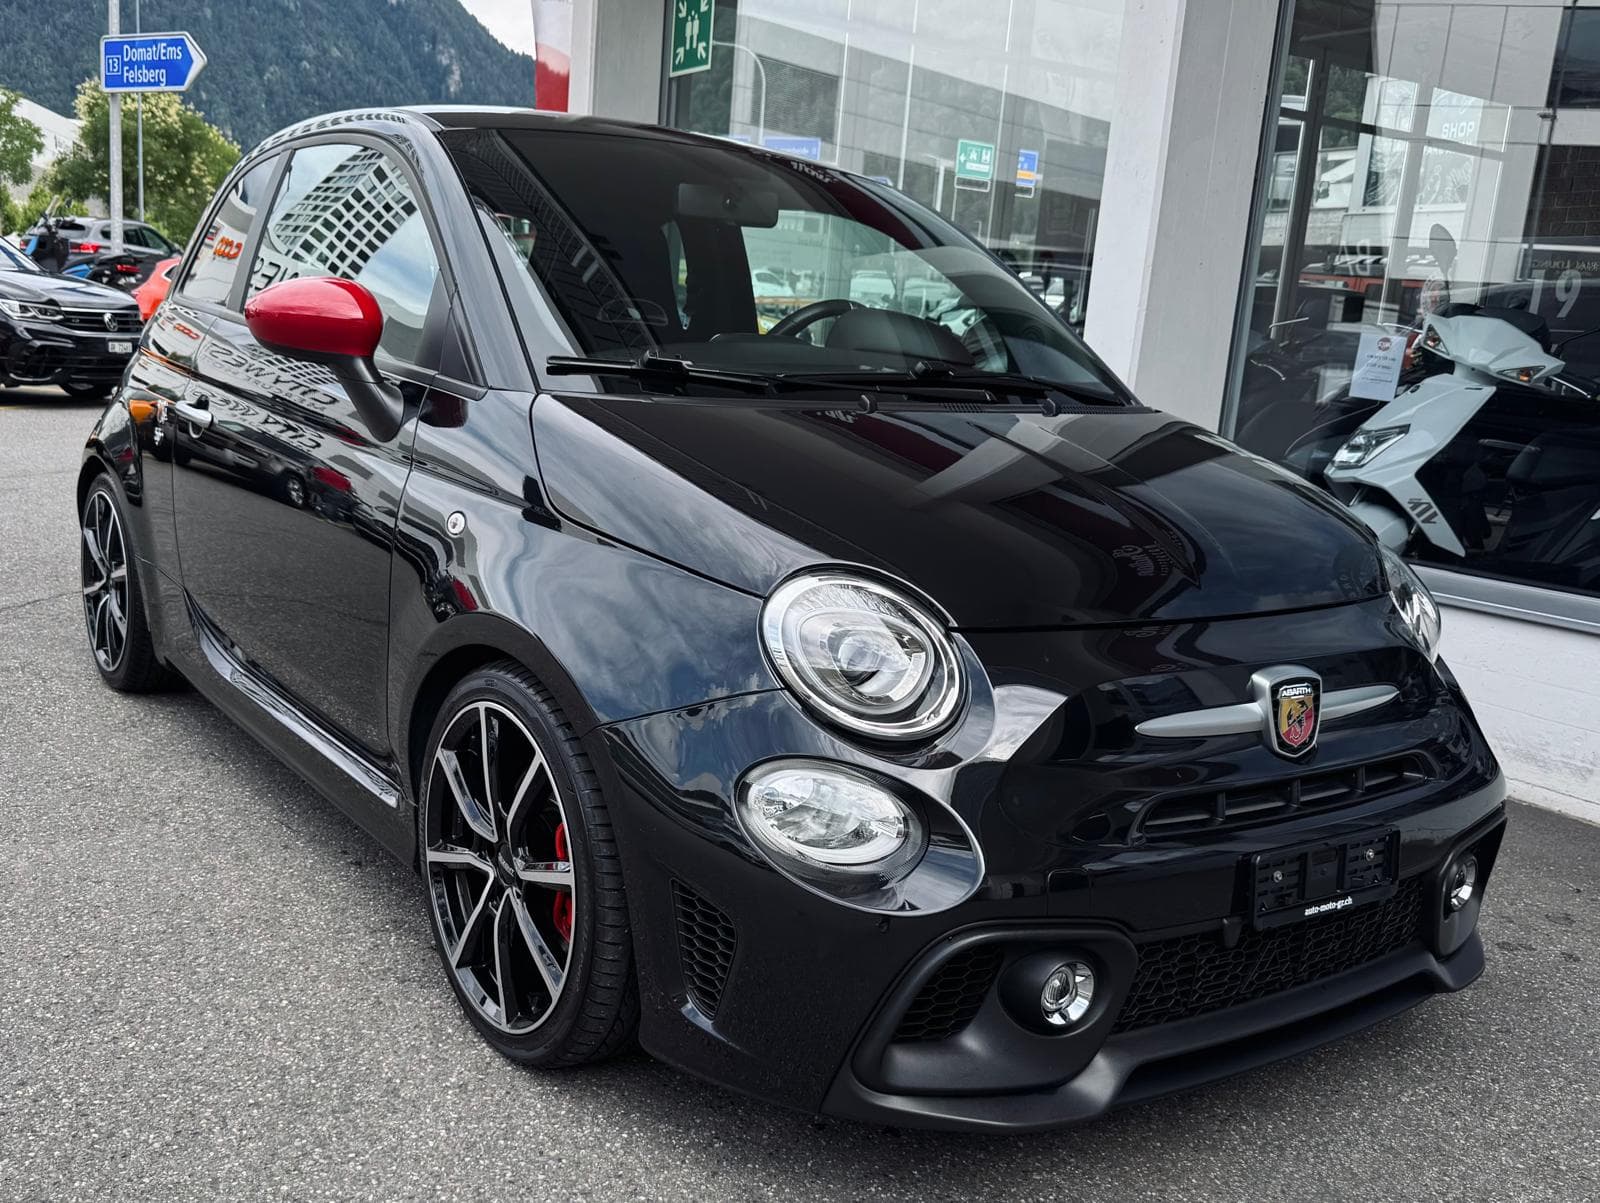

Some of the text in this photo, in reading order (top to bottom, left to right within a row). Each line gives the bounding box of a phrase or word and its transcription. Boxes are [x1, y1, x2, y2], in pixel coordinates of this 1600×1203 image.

[123, 43, 182, 62] Domat/Ems
[108, 58, 119, 72] 13
[123, 65, 166, 87] Felsberg
[1441, 121, 1475, 138] SHOP
[1281, 687, 1312, 697] ABARTH
[1304, 895, 1353, 916] auto-moto-gr.ch
